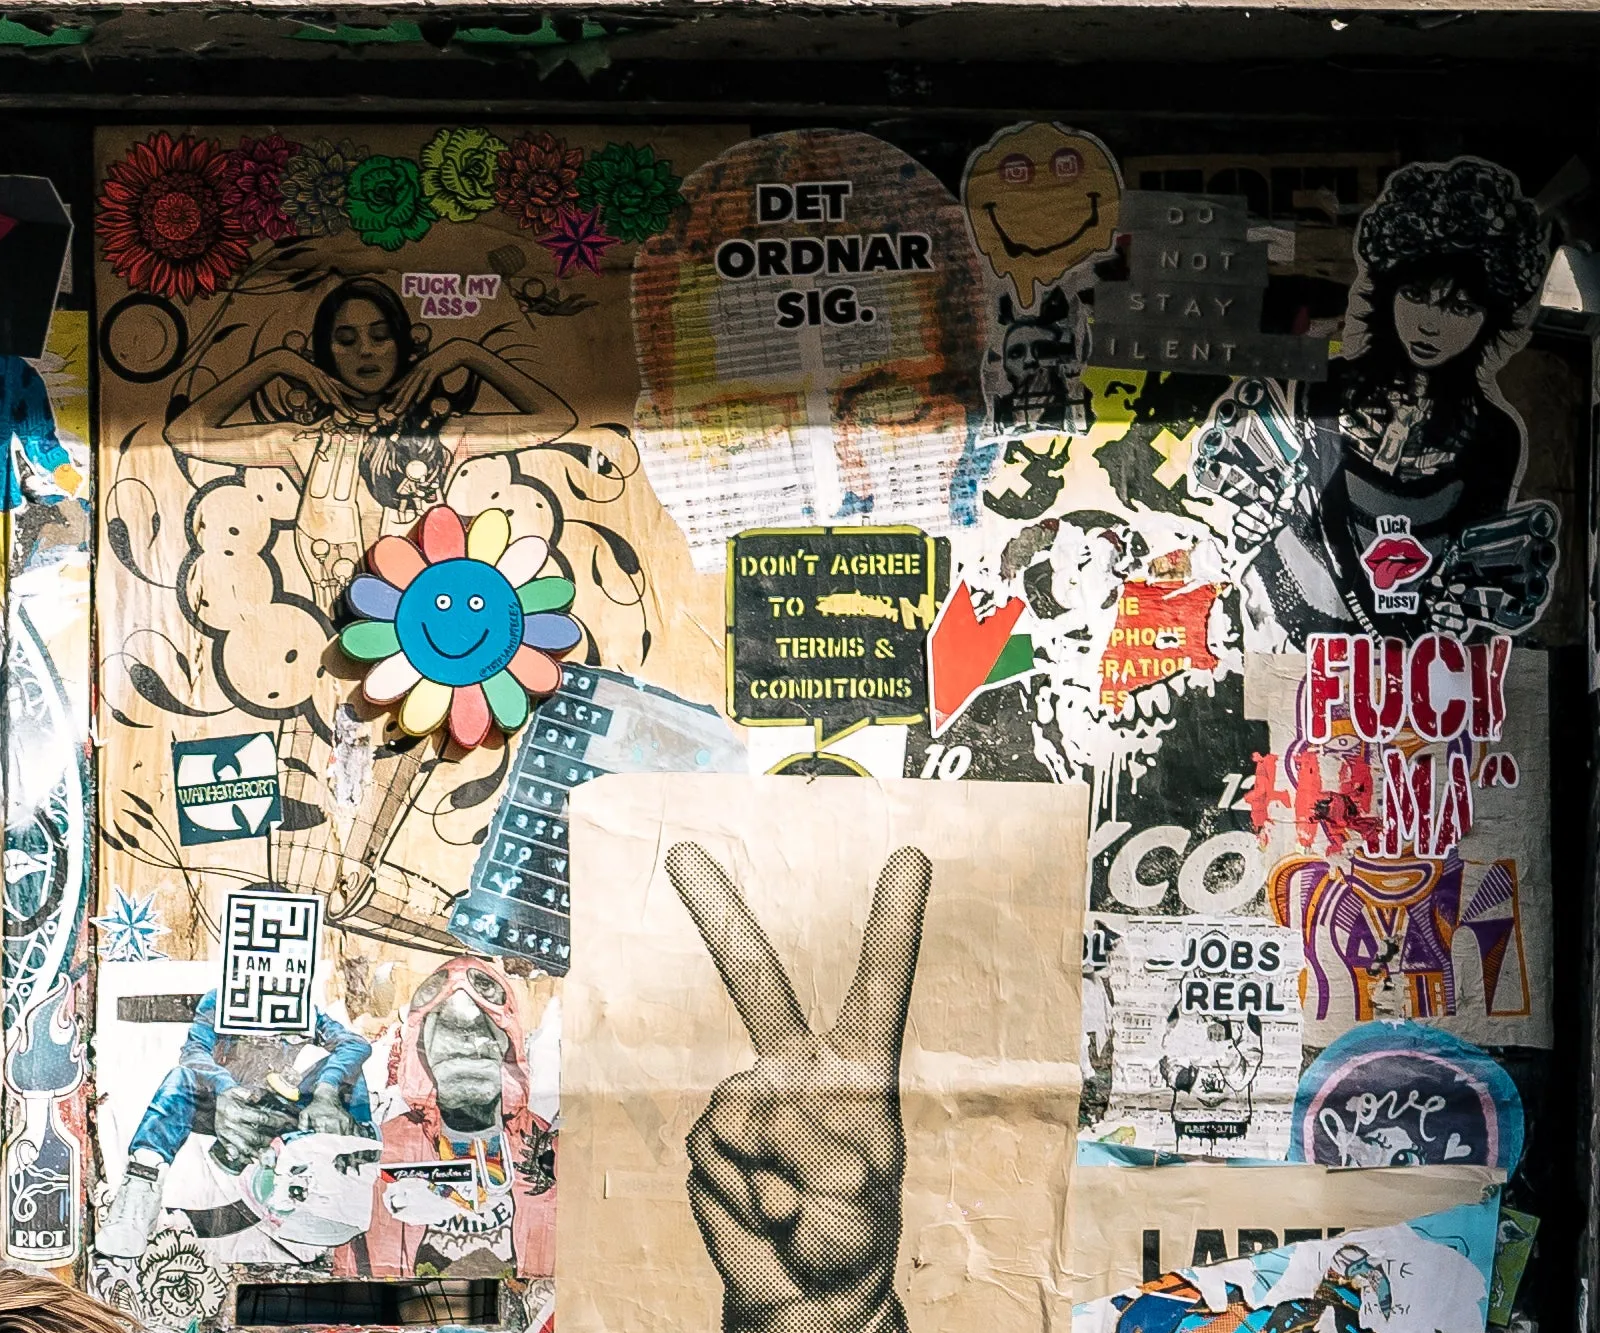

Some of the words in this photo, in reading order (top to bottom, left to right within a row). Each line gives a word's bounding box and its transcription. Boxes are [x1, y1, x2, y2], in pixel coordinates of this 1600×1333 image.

[758, 185, 849, 224] DET
[717, 237, 931, 277] ORDNAR
[1161, 251, 1234, 271] NOT
[403, 275, 457, 295] FUCK
[467, 275, 498, 297] MY
[423, 299, 465, 316] ASS
[777, 292, 874, 327] SIG.
[1130, 293, 1233, 317] STAY
[741, 549, 819, 577] DON'T
[830, 554, 921, 576] AGREE
[768, 596, 805, 618] TO
[775, 637, 865, 659] TERMS
[874, 638, 896, 659] &
[750, 678, 913, 699] CONDITIONS
[247, 957, 271, 972] AM
[286, 959, 307, 974] AN
[1181, 939, 1281, 973] JOBS
[1185, 981, 1286, 1012] REAL
[15, 1231, 66, 1248] RIOT
